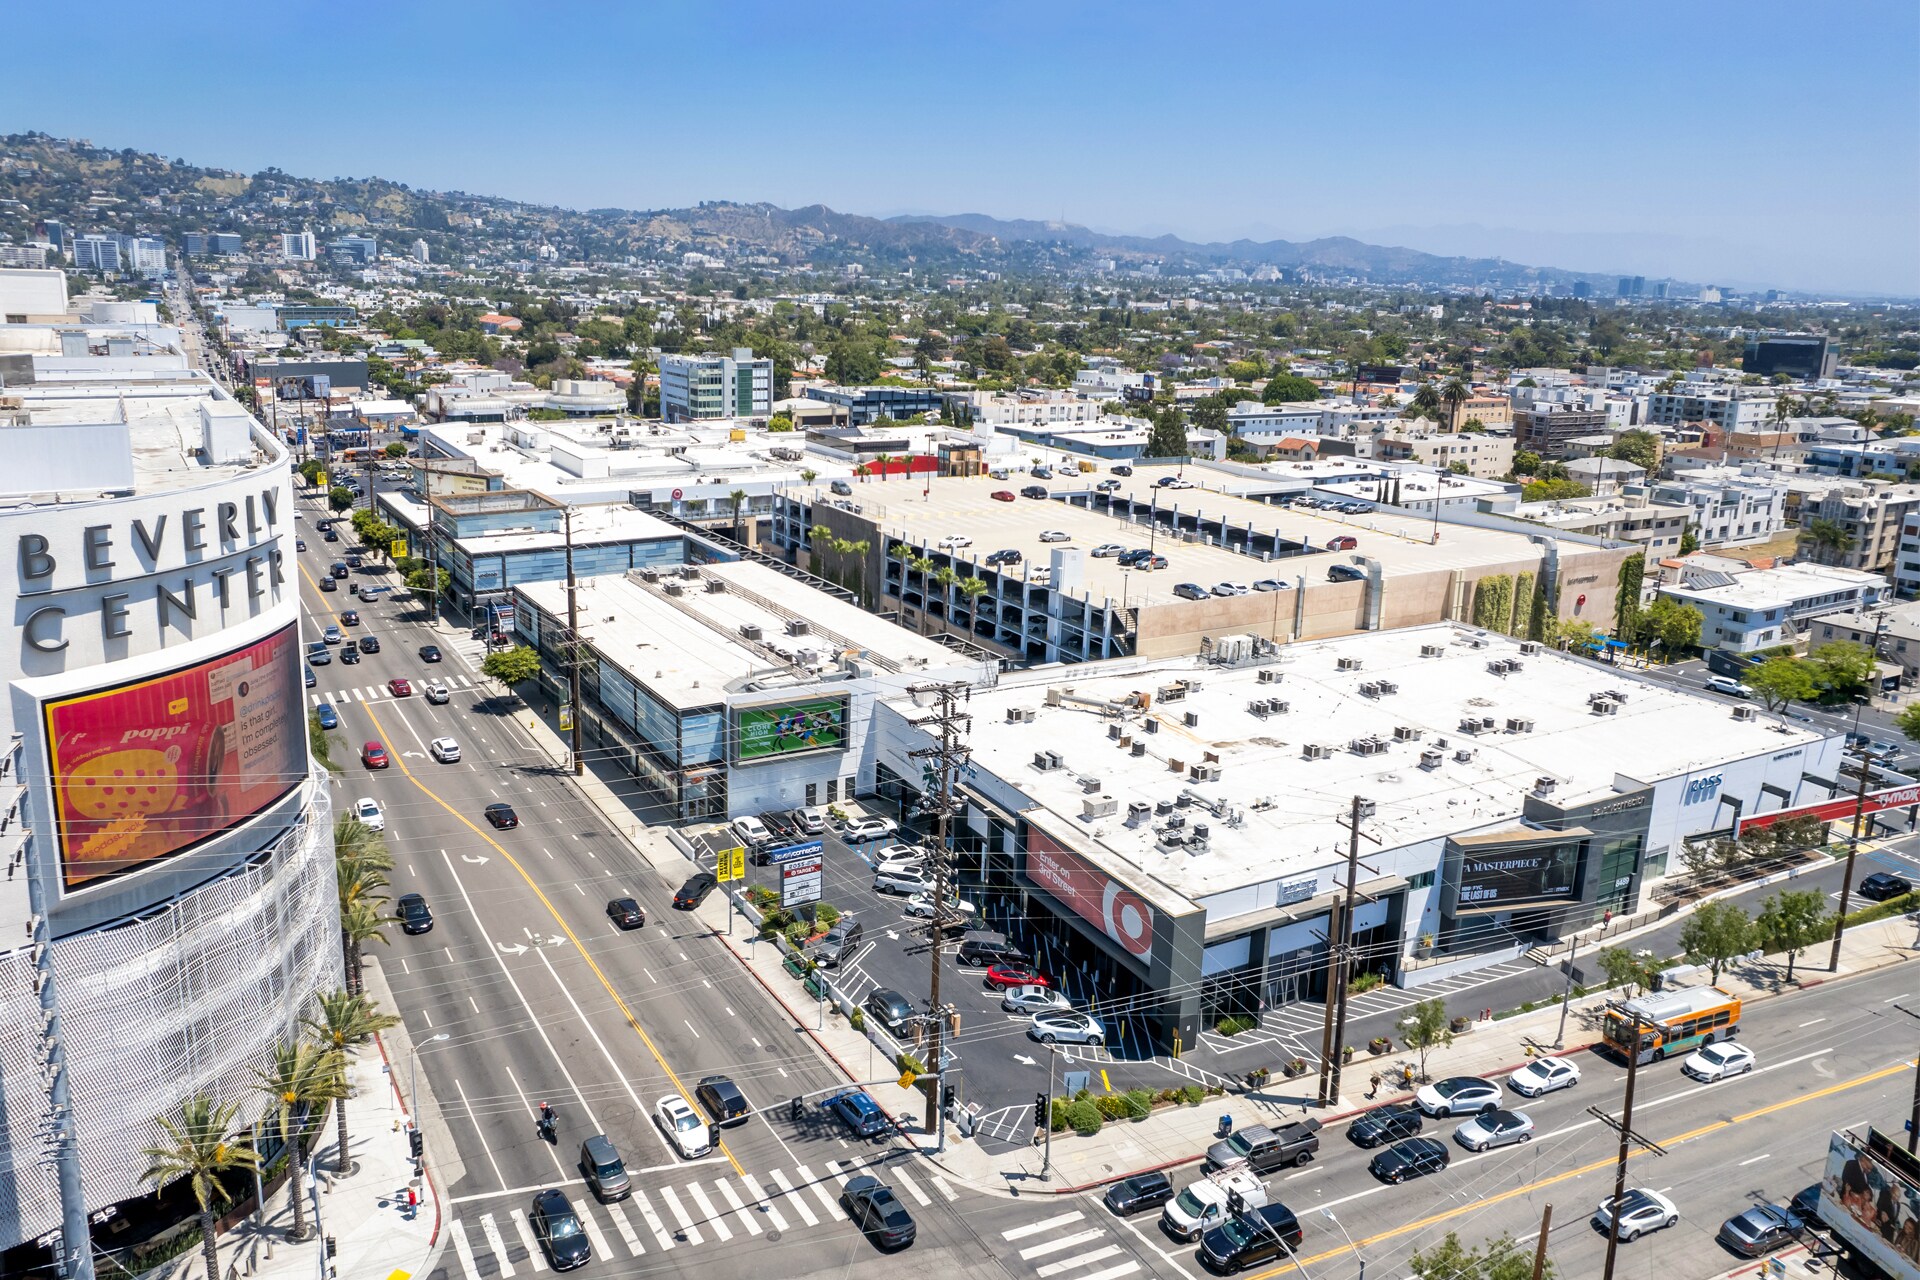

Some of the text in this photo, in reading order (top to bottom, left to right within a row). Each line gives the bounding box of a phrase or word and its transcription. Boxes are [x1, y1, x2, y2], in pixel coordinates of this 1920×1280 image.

[19, 486, 280, 580] BEVERLY
[23, 550, 285, 653] CENTER
[120, 722, 191, 744] poppi
[240, 721, 248, 731] is
[249, 713, 264, 727] that
[748, 723, 771, 732] CLONE
[242, 731, 254, 745] I'm
[243, 734, 280, 759] obsessed.
[1691, 773, 1723, 792] ROSS
[84, 821, 141, 858] #sodasback
[796, 866, 815, 875] TARGET
[1039, 850, 1071, 880] Enter on
[1038, 862, 1076, 898] 3rd Street
[1460, 891, 1471, 901] THE
[1470, 890, 1483, 900] LAST
